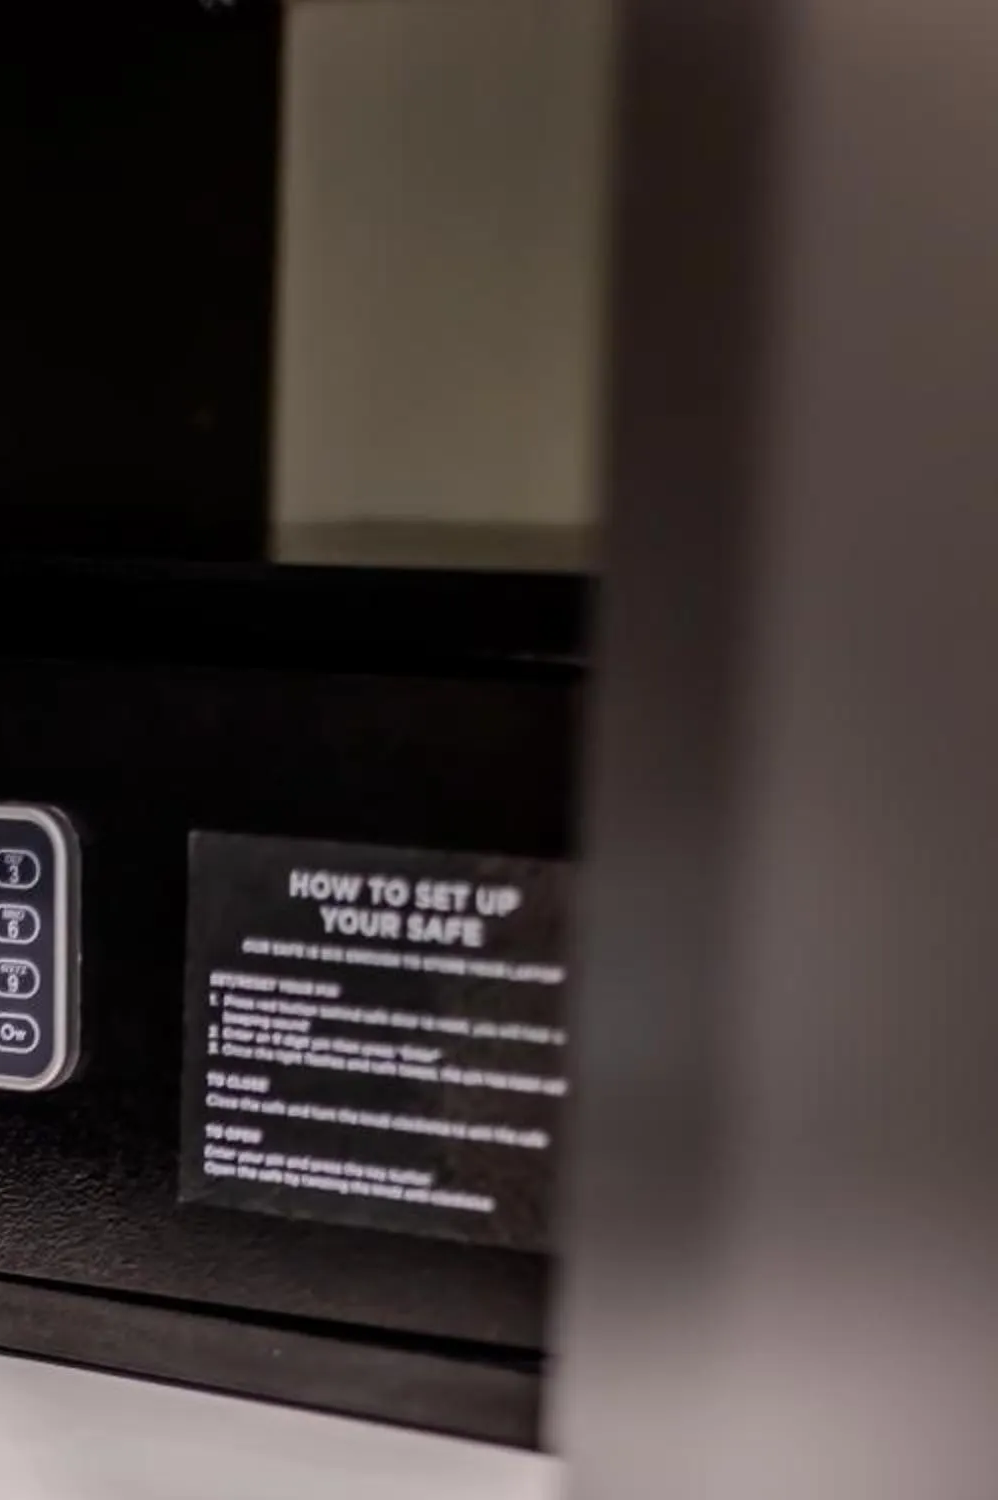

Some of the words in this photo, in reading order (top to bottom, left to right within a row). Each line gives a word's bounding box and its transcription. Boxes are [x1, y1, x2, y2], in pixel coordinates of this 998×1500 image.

[9, 865, 19, 884] 3
[289, 869, 363, 902] HOW
[367, 875, 410, 907] TO
[415, 878, 472, 912] SET
[475, 885, 522, 917] UP
[7, 920, 18, 939] 6
[319, 905, 402, 939] YOUR
[406, 912, 485, 948] SAFE
[7, 974, 18, 993] 9
